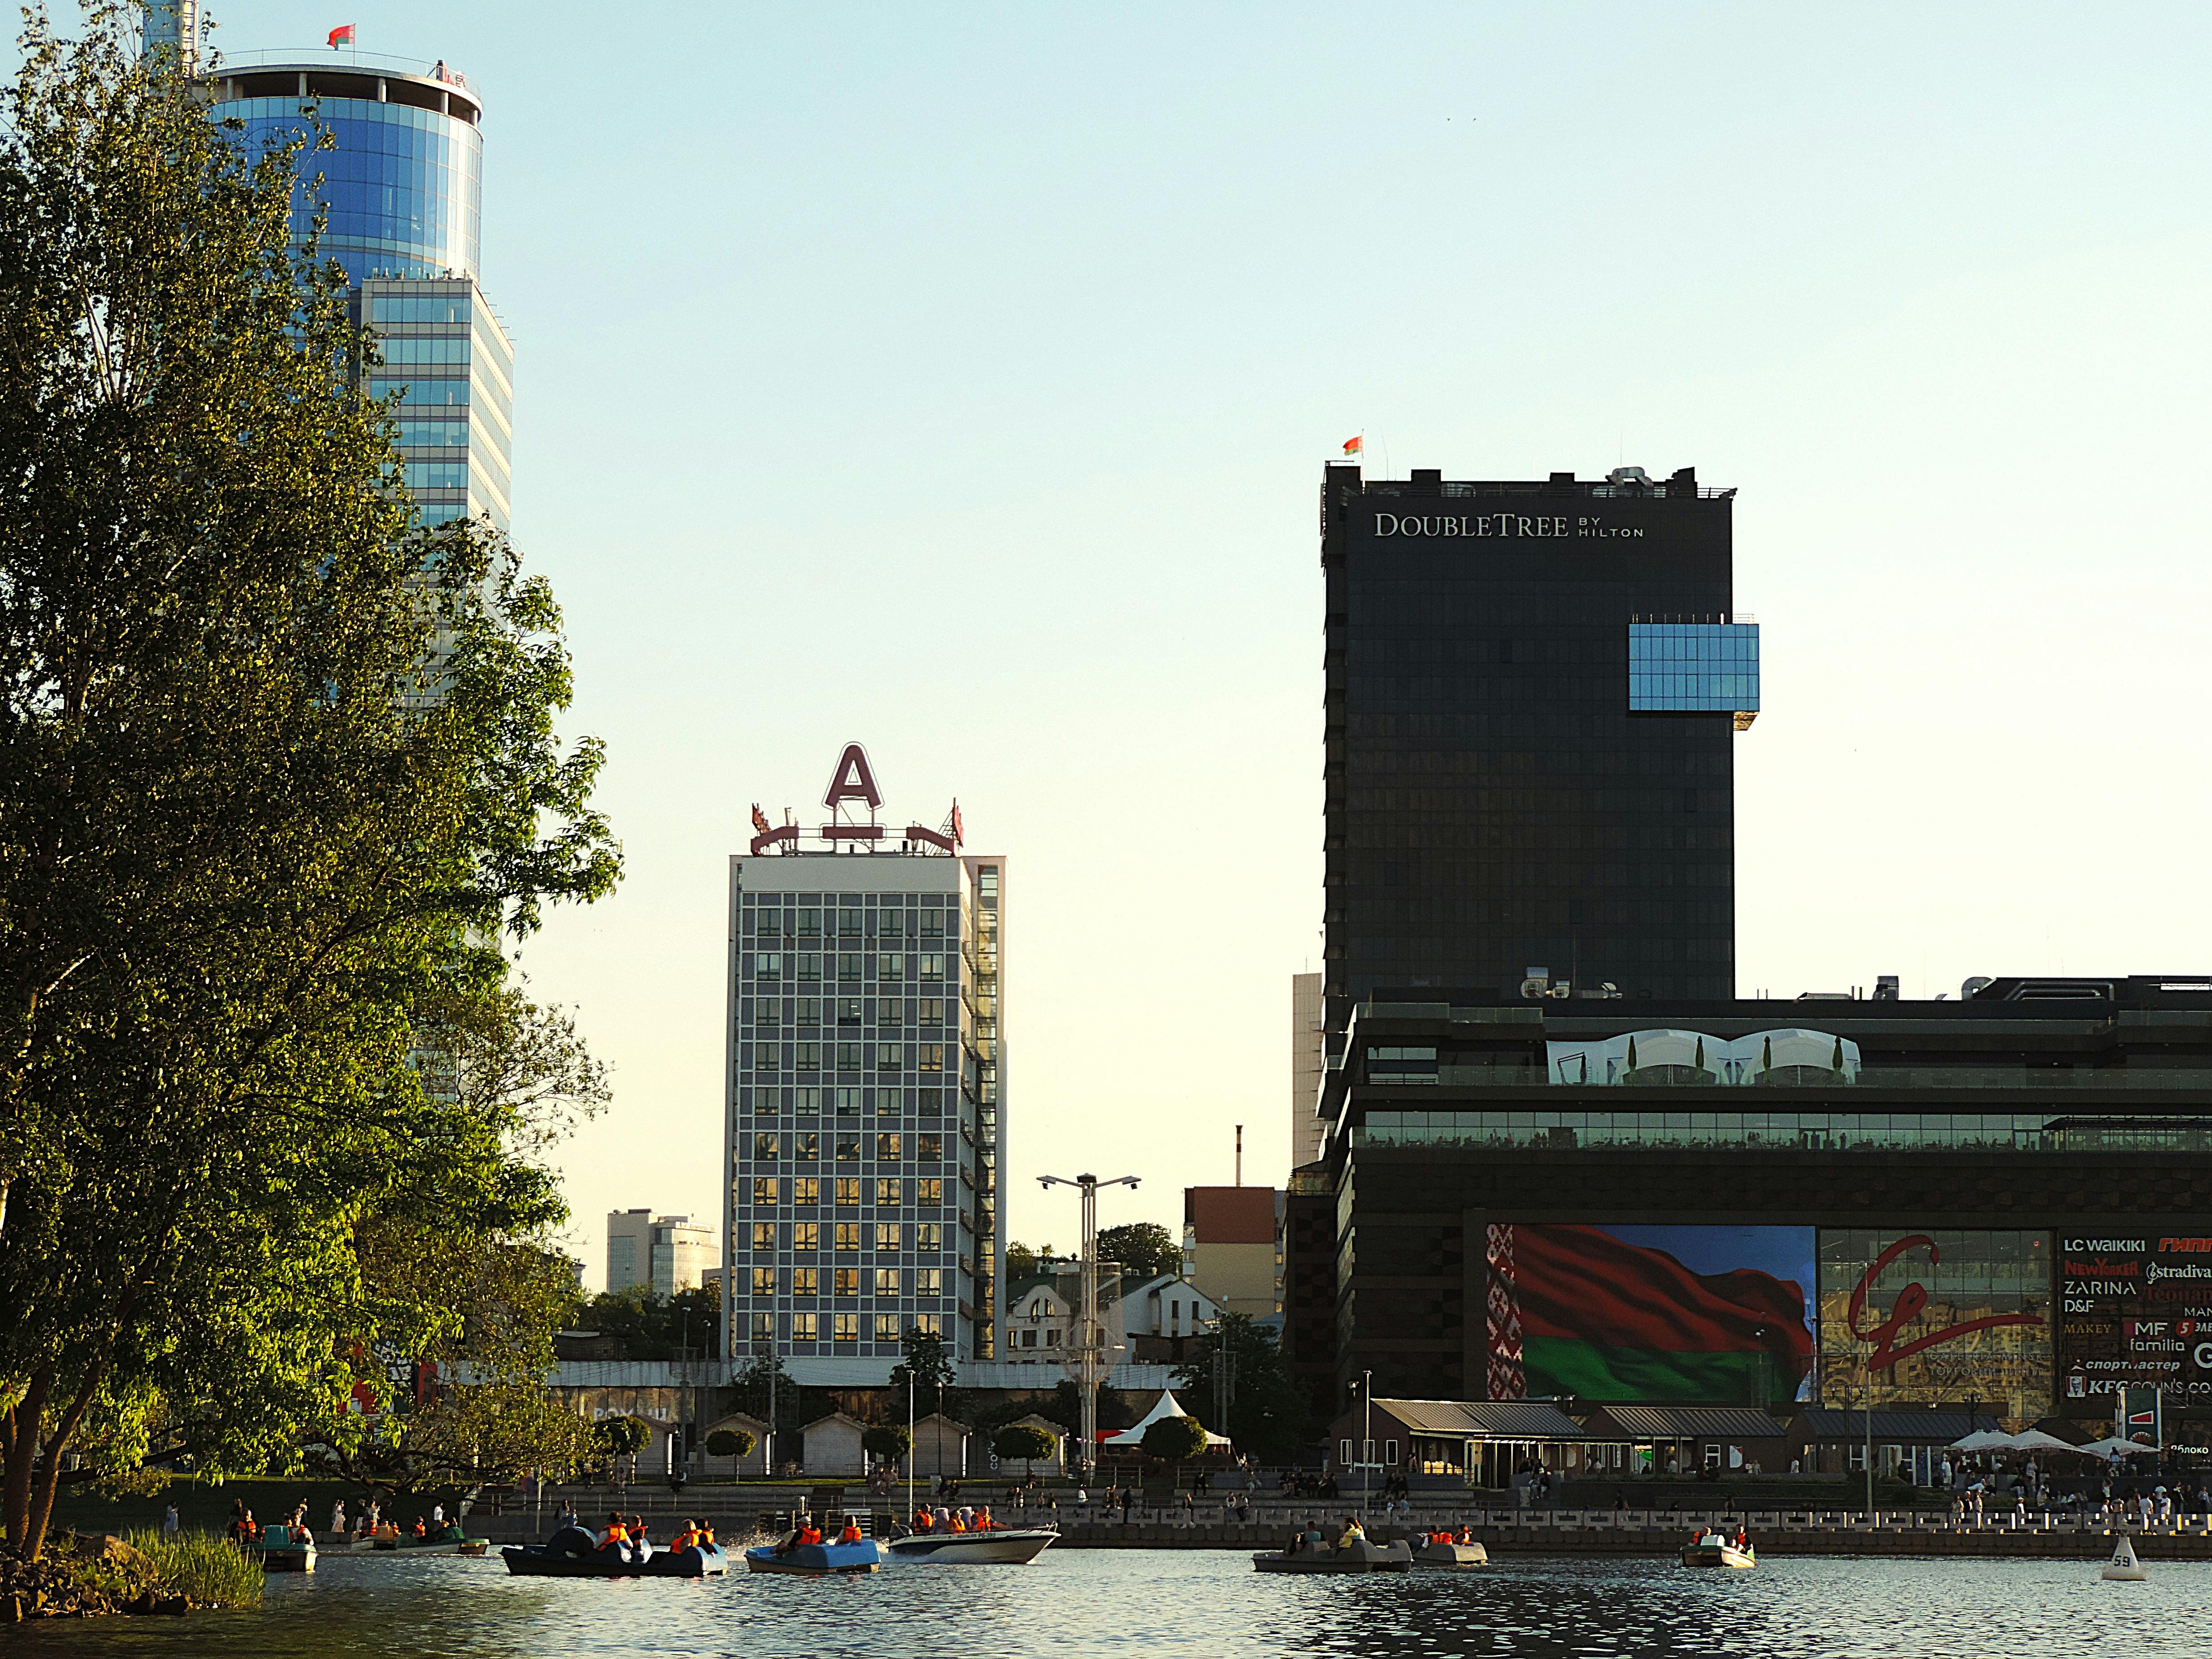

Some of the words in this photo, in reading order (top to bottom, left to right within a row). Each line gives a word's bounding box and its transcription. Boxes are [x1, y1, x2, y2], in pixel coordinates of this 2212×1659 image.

[1579, 517, 1600, 526] BY
[1579, 528, 1644, 537] HILTON
[2064, 1239, 2084, 1251] LC
[2156, 1265, 2212, 1278] stradiva
[2064, 1281, 2137, 1295] ZARINA
[2064, 1299, 2095, 1312] D&F
[2064, 1324, 2111, 1333] MAKEY
[2135, 1322, 2168, 1336] MF
[2180, 1322, 2189, 1334] 5
[2130, 1338, 2185, 1351] familia
[2085, 1361, 2180, 1372] спортмастер
[2088, 1381, 2128, 1393] KFC
[2189, 1382, 2212, 1393] CO
[2114, 1555, 2130, 1567] 59
